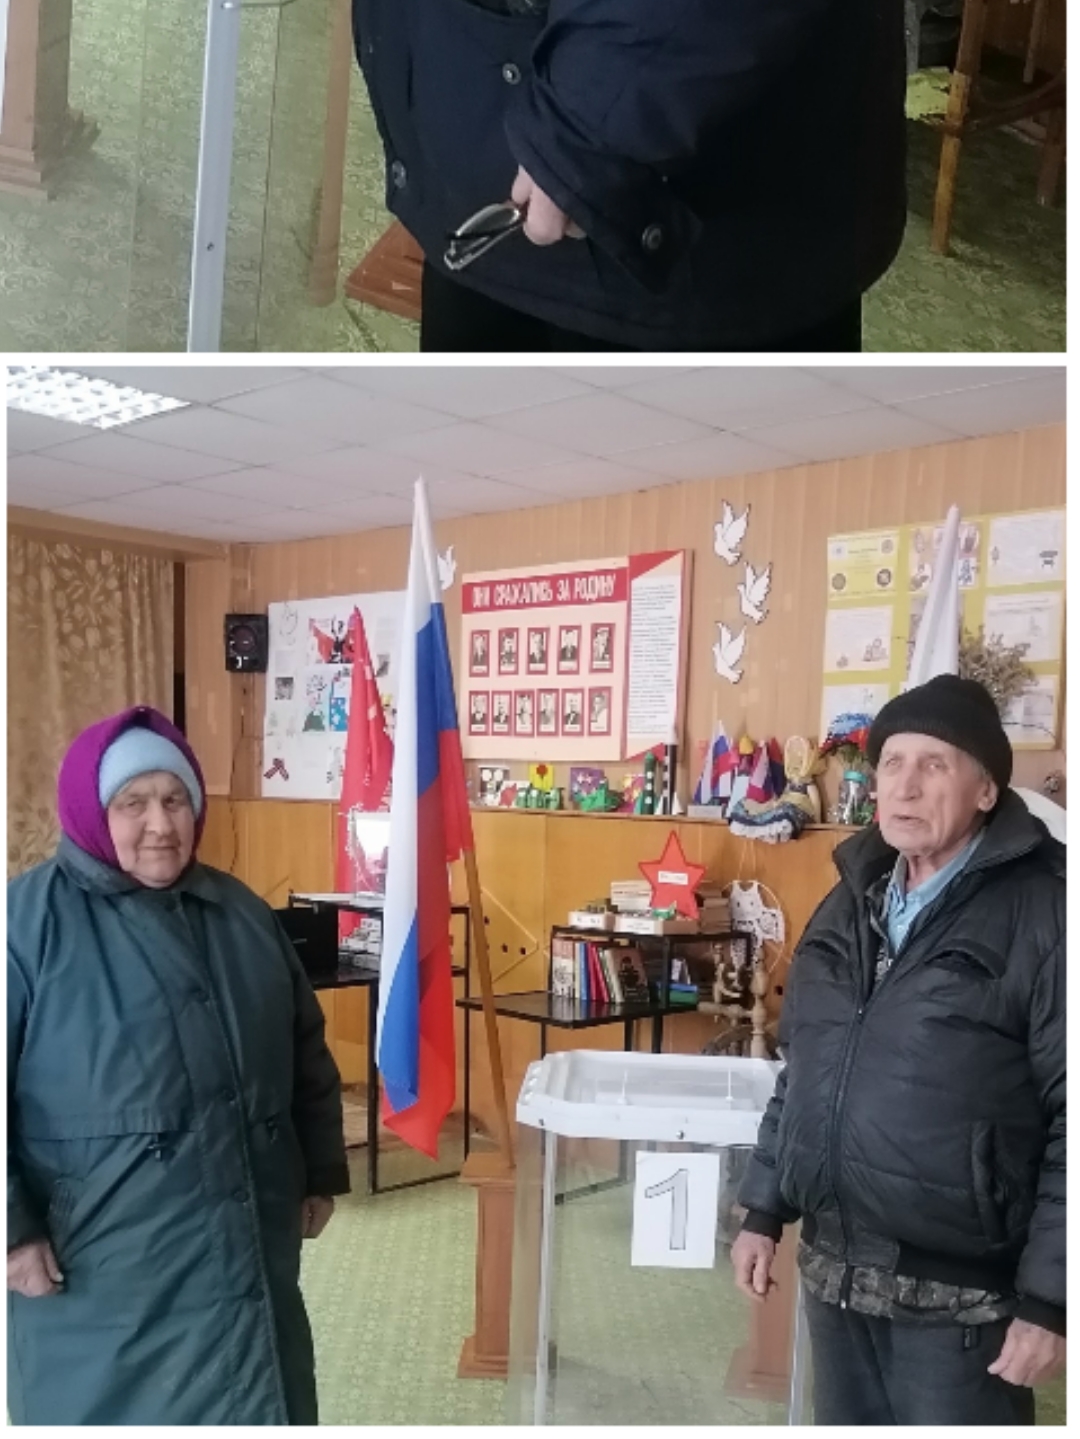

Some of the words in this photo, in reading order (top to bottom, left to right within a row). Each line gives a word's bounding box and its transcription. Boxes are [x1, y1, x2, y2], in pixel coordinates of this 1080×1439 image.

[472, 586, 490, 608] ОНИ
[494, 580, 553, 606] СРАЖАЛИСЬ
[556, 578, 570, 601] ЗА
[574, 573, 616, 601] РОДИНУ
[644, 1168, 688, 1251] 1
